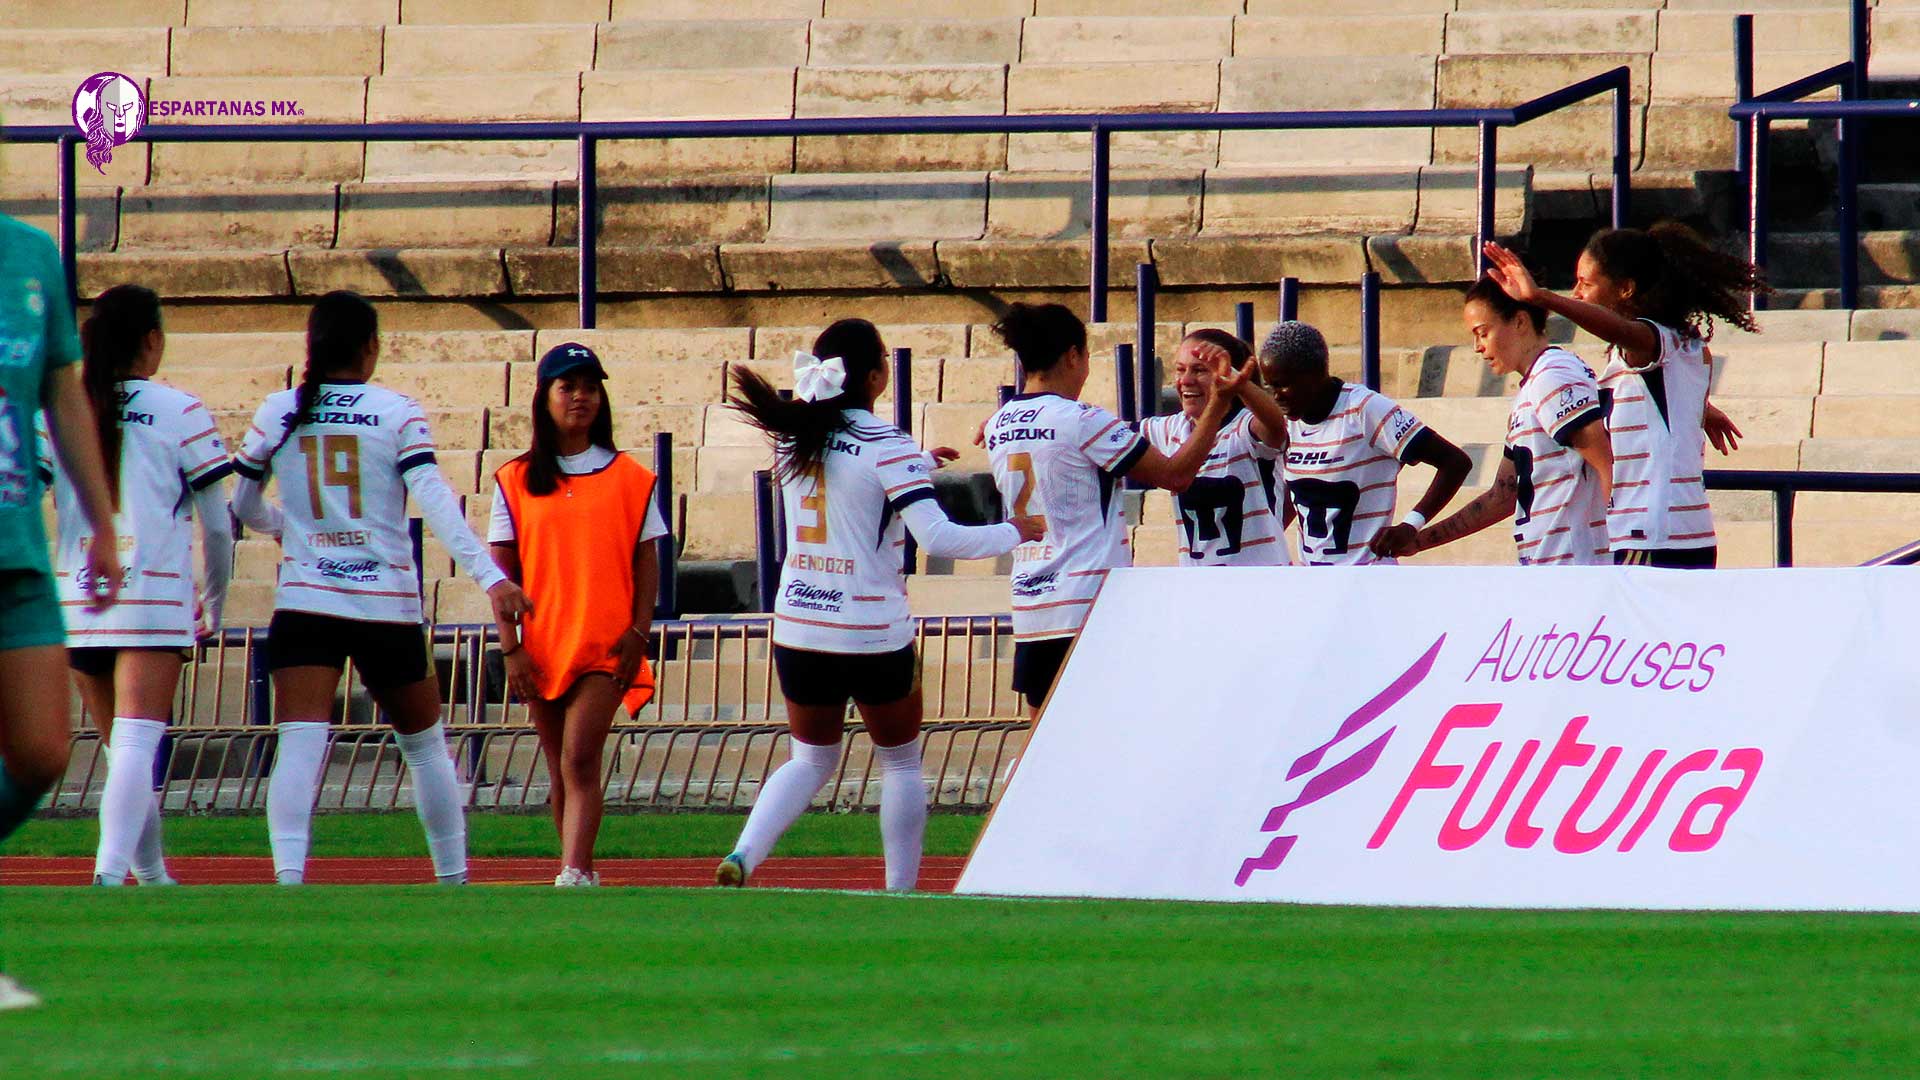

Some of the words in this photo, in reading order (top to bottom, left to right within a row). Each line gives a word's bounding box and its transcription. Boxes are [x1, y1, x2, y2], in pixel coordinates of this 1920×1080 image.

[996, 405, 1046, 428] telcel
[1556, 396, 1590, 420] RALOY
[999, 428, 1056, 445] SUZUKI
[1287, 451, 1345, 466] DHL
[299, 435, 363, 520] 19
[796, 459, 828, 545] 3
[1006, 452, 1049, 532] 2
[306, 529, 372, 548] YANEISY
[787, 553, 855, 576] MENDOZA
[785, 579, 844, 603] Caliente
[1465, 615, 1725, 693] Autobuses
[1366, 702, 1764, 855] Futura
